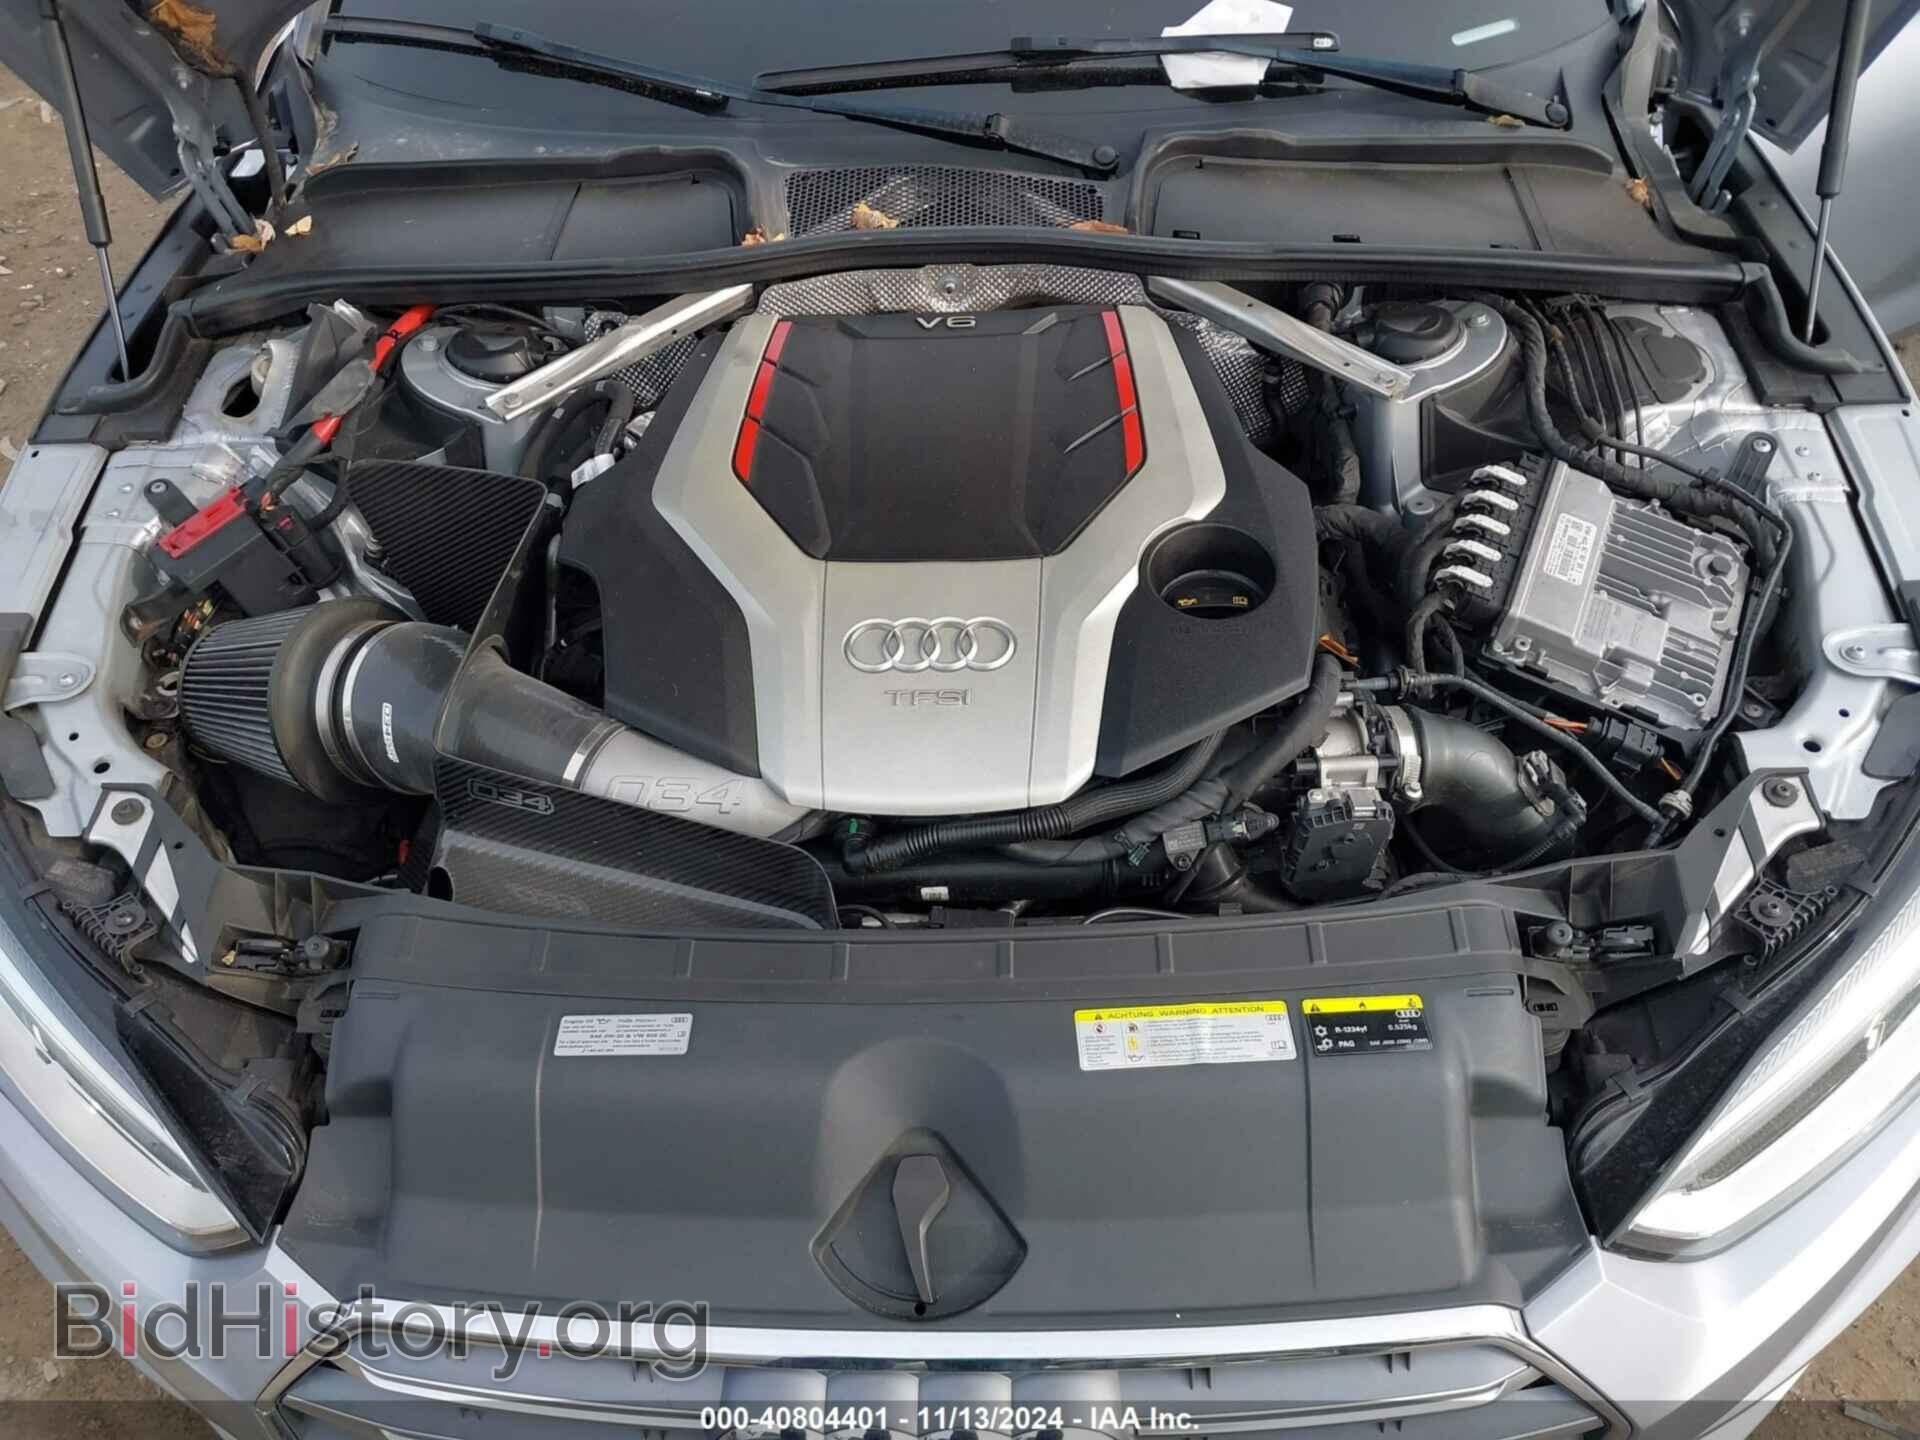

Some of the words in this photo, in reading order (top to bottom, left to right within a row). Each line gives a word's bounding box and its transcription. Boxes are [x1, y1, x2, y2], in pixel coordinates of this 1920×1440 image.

[915, 315, 976, 329] V6
[883, 688, 975, 706] TFSI
[1107, 1010, 1154, 1020] ACHTUNG
[1159, 1007, 1207, 1017] WARNING
[1210, 1005, 1265, 1015] ATTENTION
